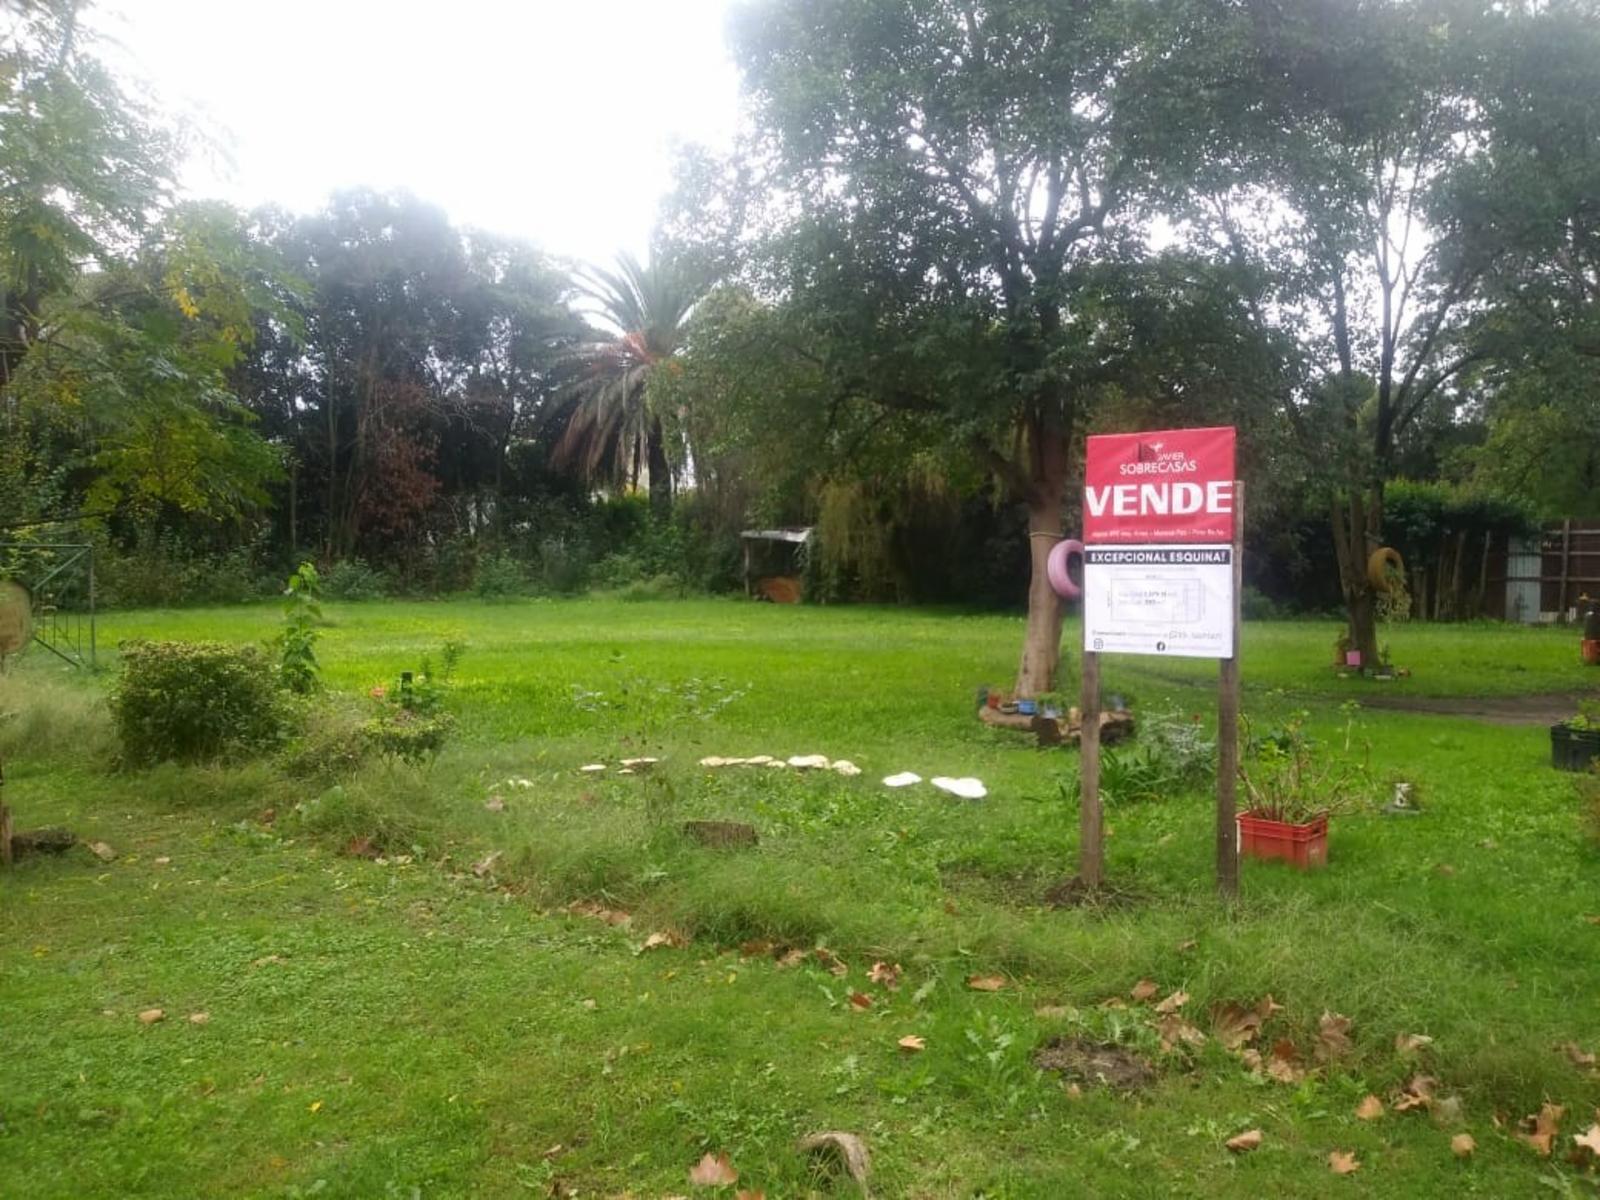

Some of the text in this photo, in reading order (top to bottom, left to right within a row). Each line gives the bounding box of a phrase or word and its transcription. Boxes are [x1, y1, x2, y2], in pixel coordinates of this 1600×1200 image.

[1120, 460, 1197, 475] SOBRECASAS
[1085, 480, 1232, 517] VENDE
[1091, 551, 1226, 562] EXCEPCIONAL ESQUINA!
